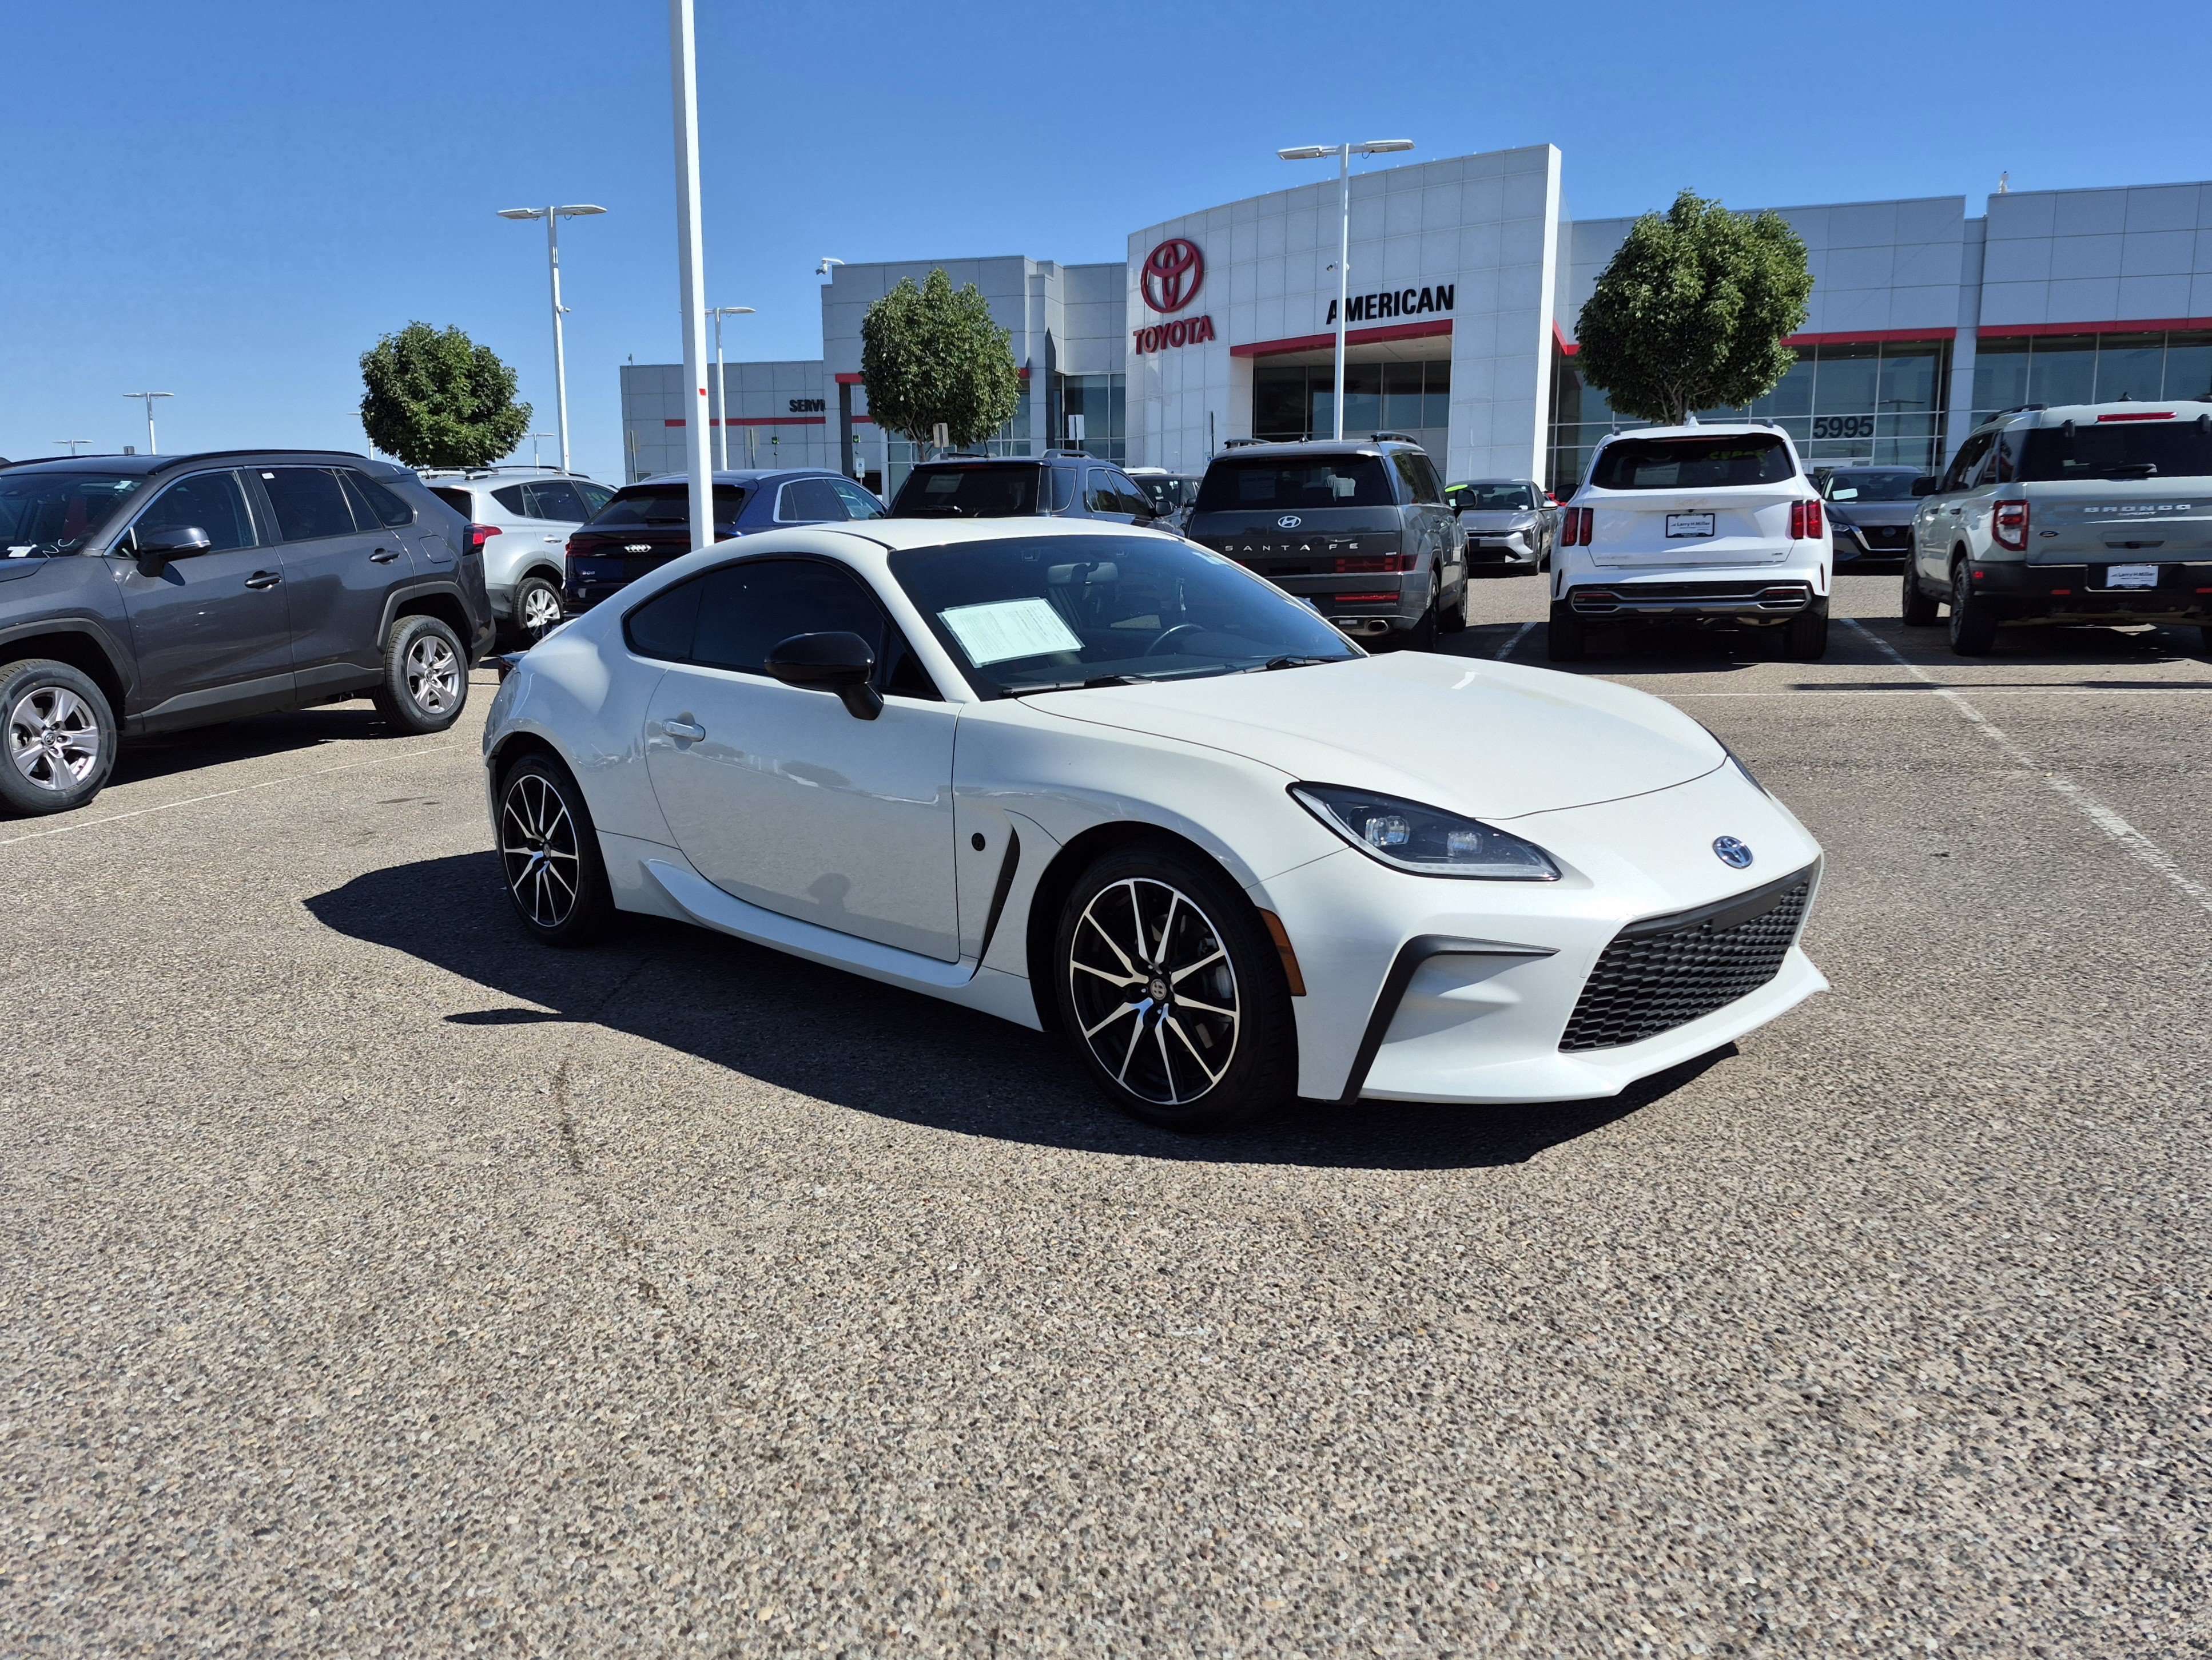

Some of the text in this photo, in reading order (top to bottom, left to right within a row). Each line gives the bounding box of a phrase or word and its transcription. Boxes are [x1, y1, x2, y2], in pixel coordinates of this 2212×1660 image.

[1326, 284, 1454, 324] AMERICAN
[1133, 315, 1215, 355] TOYOTA
[1812, 416, 1874, 438] 5995
[2084, 505, 2191, 513] BRONCO
